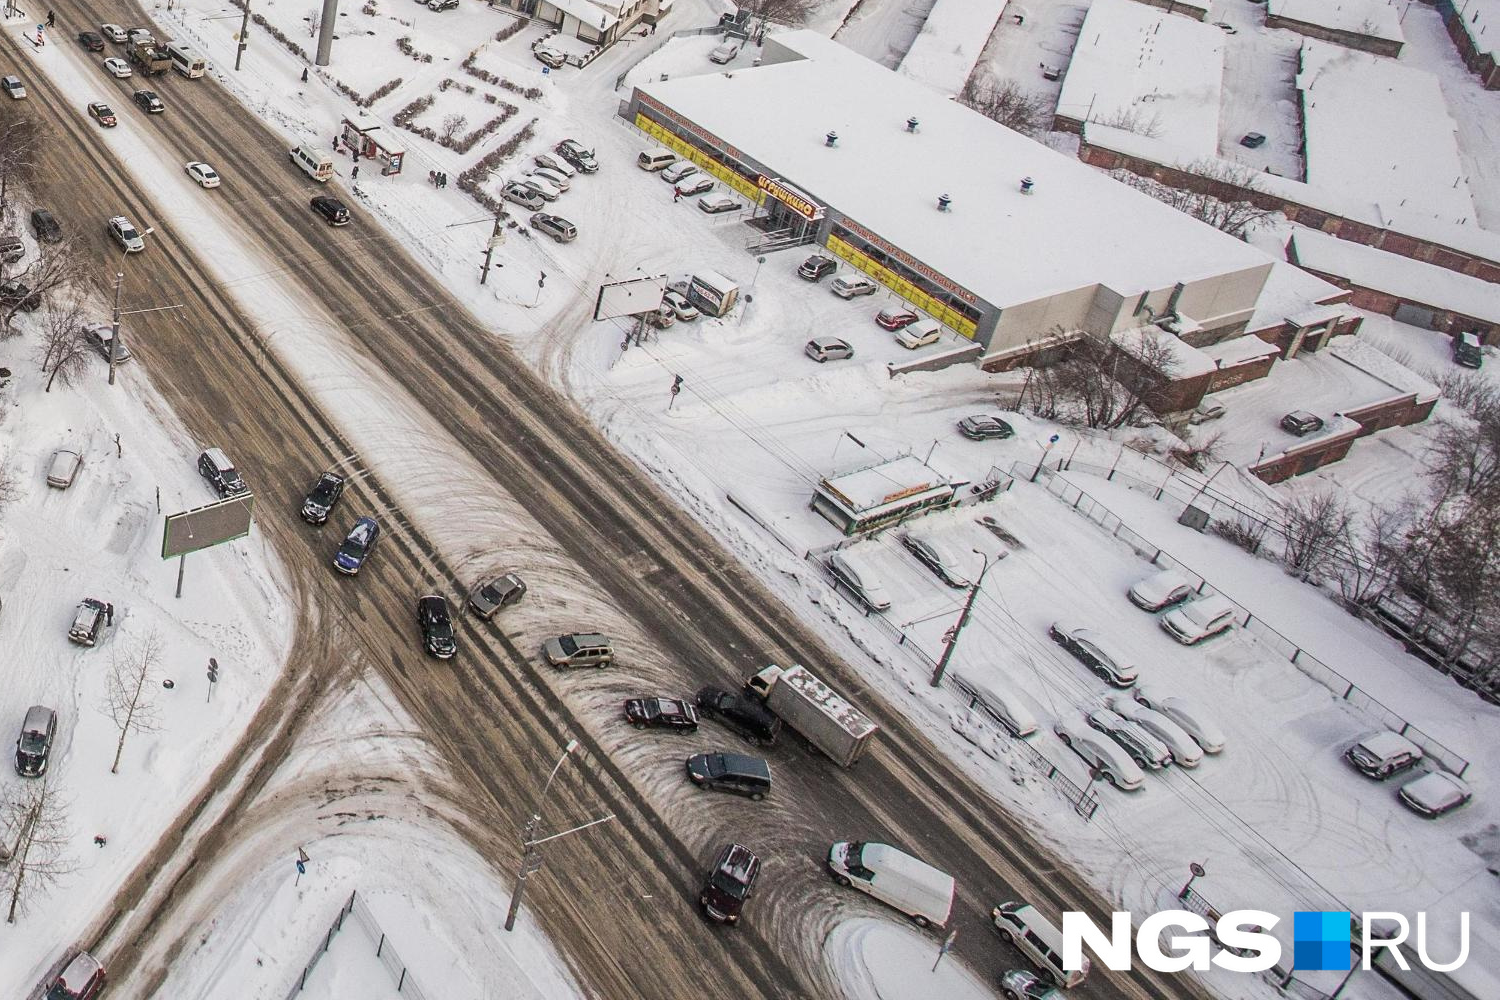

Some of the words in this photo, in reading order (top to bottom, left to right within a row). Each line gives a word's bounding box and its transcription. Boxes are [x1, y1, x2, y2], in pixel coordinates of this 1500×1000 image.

[842, 217, 880, 244] БОЛЬШОЙ
[880, 242, 916, 267] МАГАЗИН
[917, 264, 956, 291] ОПТОВЫХ
[958, 289, 977, 304] ЦЕН
